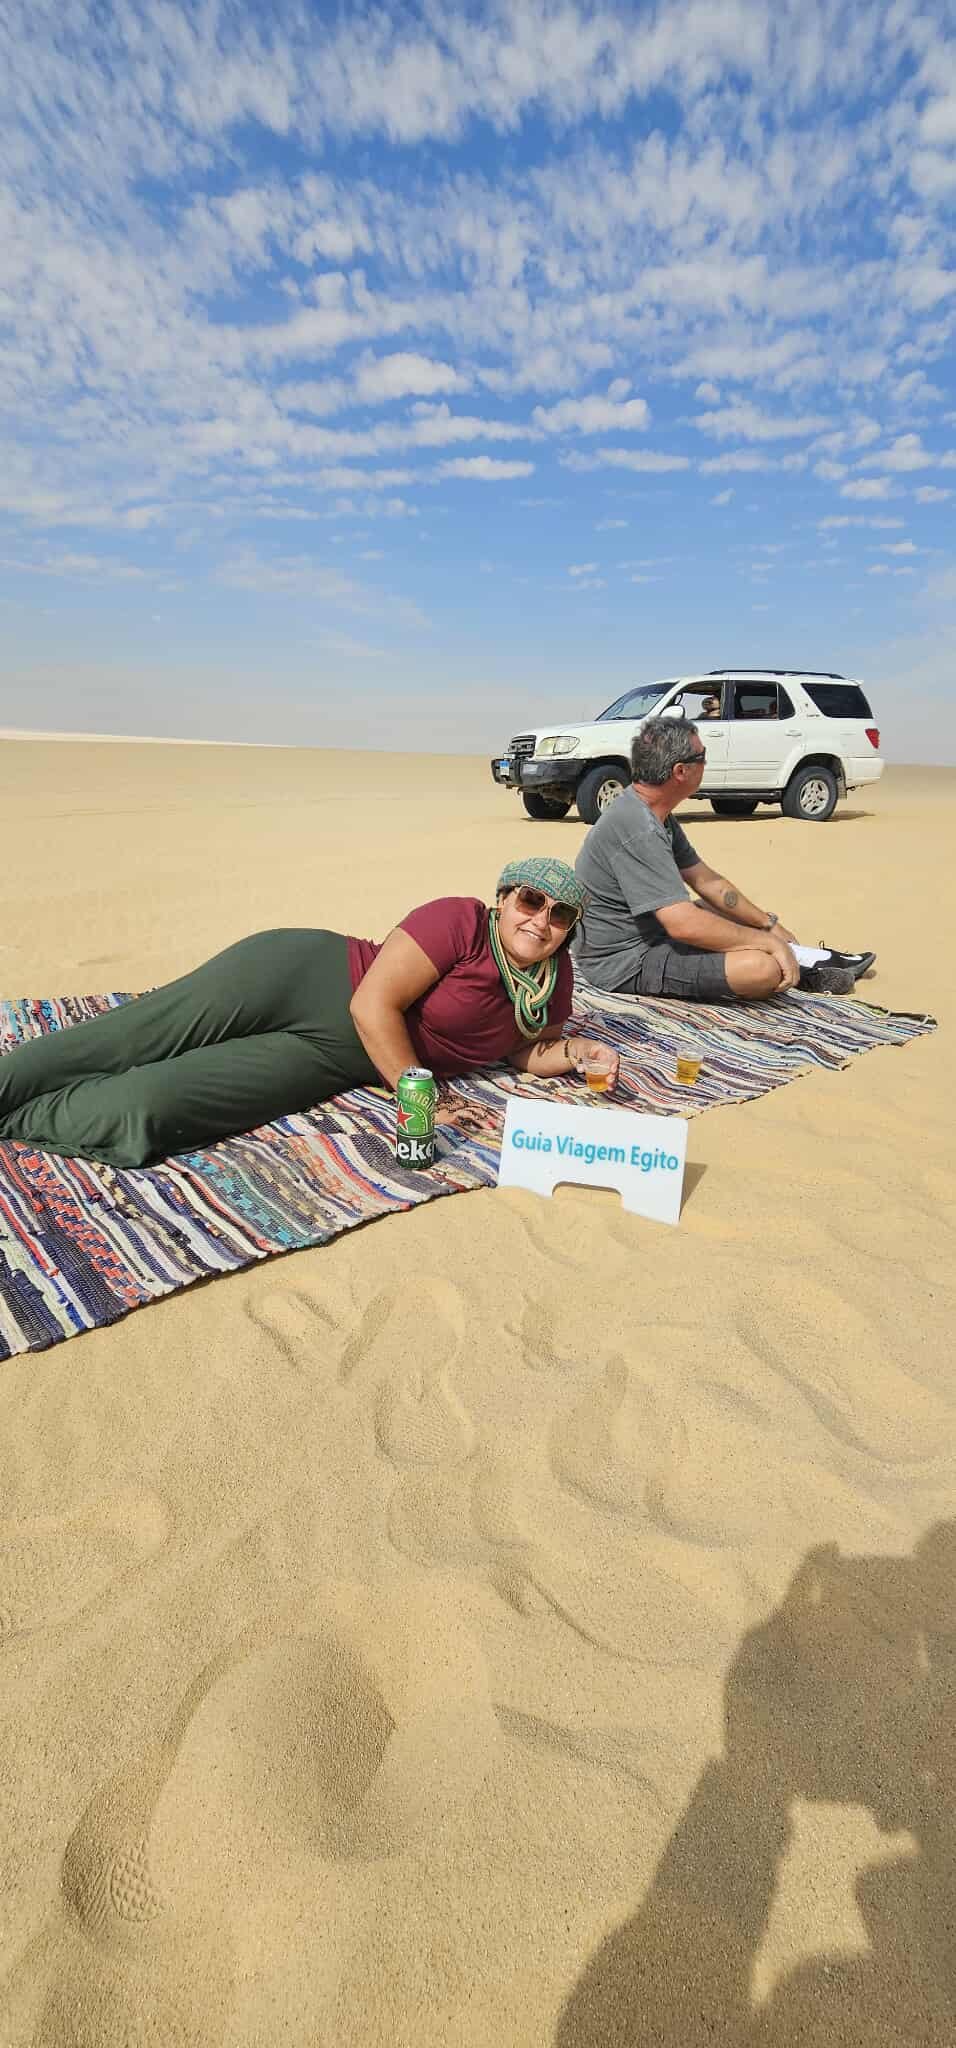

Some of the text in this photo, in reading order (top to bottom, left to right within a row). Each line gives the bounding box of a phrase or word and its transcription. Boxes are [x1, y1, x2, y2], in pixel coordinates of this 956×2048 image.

[511, 1129, 679, 1172] Guia Viagem Egito
